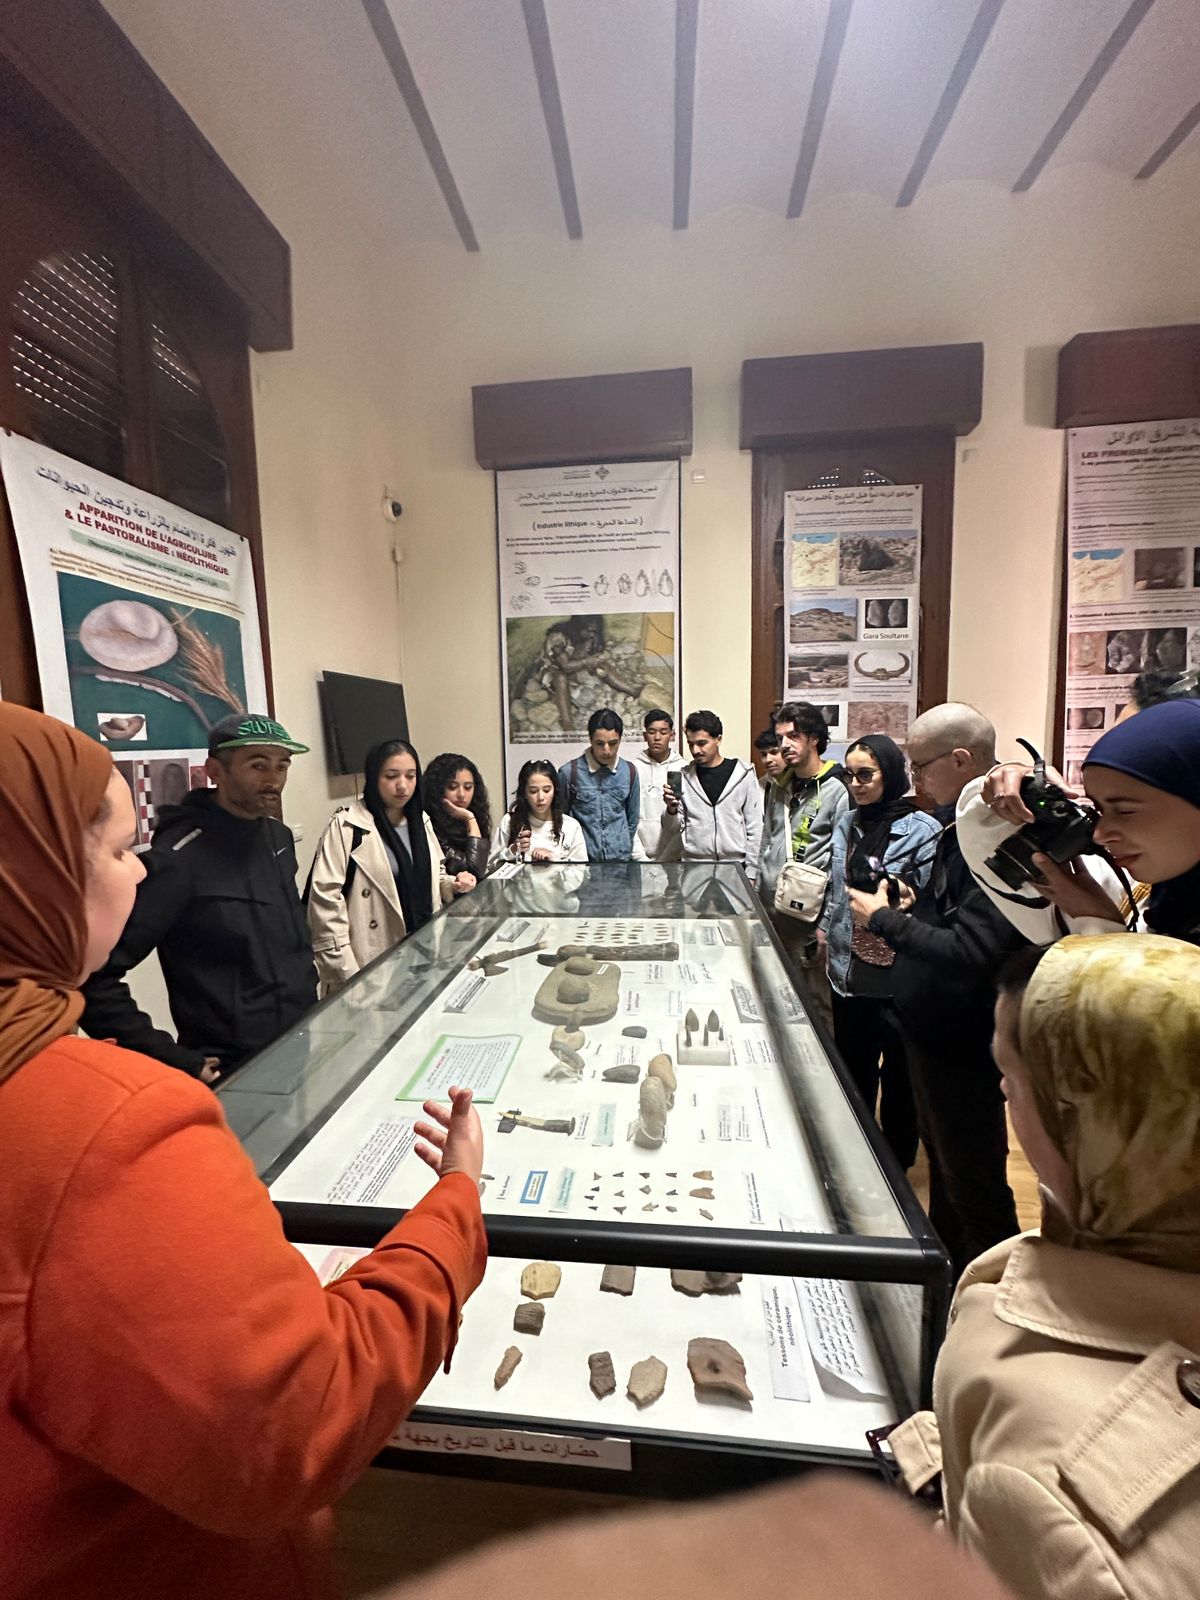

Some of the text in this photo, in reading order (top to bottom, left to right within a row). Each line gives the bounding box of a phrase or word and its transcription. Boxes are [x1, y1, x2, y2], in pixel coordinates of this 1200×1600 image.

[79, 501, 142, 533] APPARITION
[145, 526, 158, 539] DE
[65, 509, 74, 520] &
[77, 513, 92, 527] LE
[95, 520, 170, 555] PASTORALISME
[176, 550, 230, 576] NÉOLITHIQUE
[880, 632, 911, 640] Soultane
[777, 1325, 783, 1335] de
[785, 1306, 796, 1346] néolithique
[780, 1336, 788, 1368] Tessons
[444, 1433, 489, 1451] التاريخ
[494, 1437, 516, 1453] قبل
[520, 1440, 537, 1452] ما
[541, 1441, 600, 1458] حضارات
